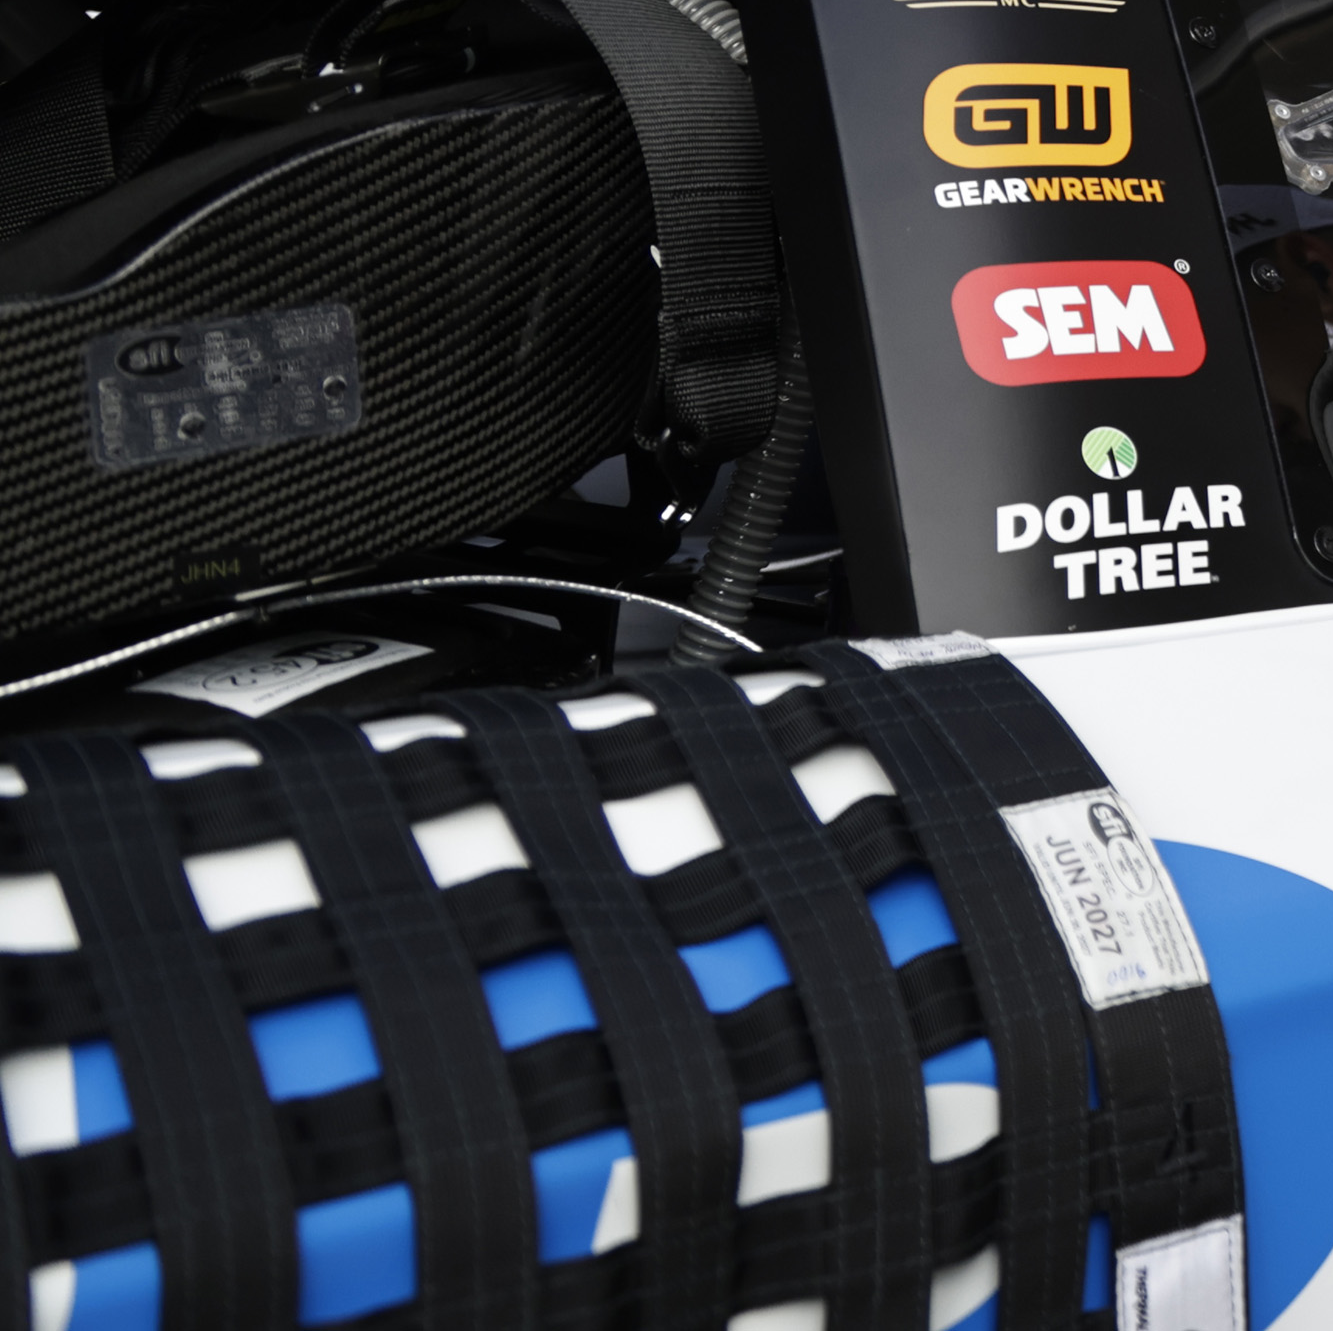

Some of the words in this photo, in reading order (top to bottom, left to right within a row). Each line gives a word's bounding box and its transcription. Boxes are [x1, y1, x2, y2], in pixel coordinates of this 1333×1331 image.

[934, 176, 1164, 209] GEARWRENCH
[993, 284, 1175, 360] SEM
[996, 484, 1246, 553] DOLLAR
[181, 557, 241, 584] JHN4
[1054, 540, 1211, 599] TREE
[1046, 833, 1088, 888] JUN
[1076, 892, 1122, 957] 2027
